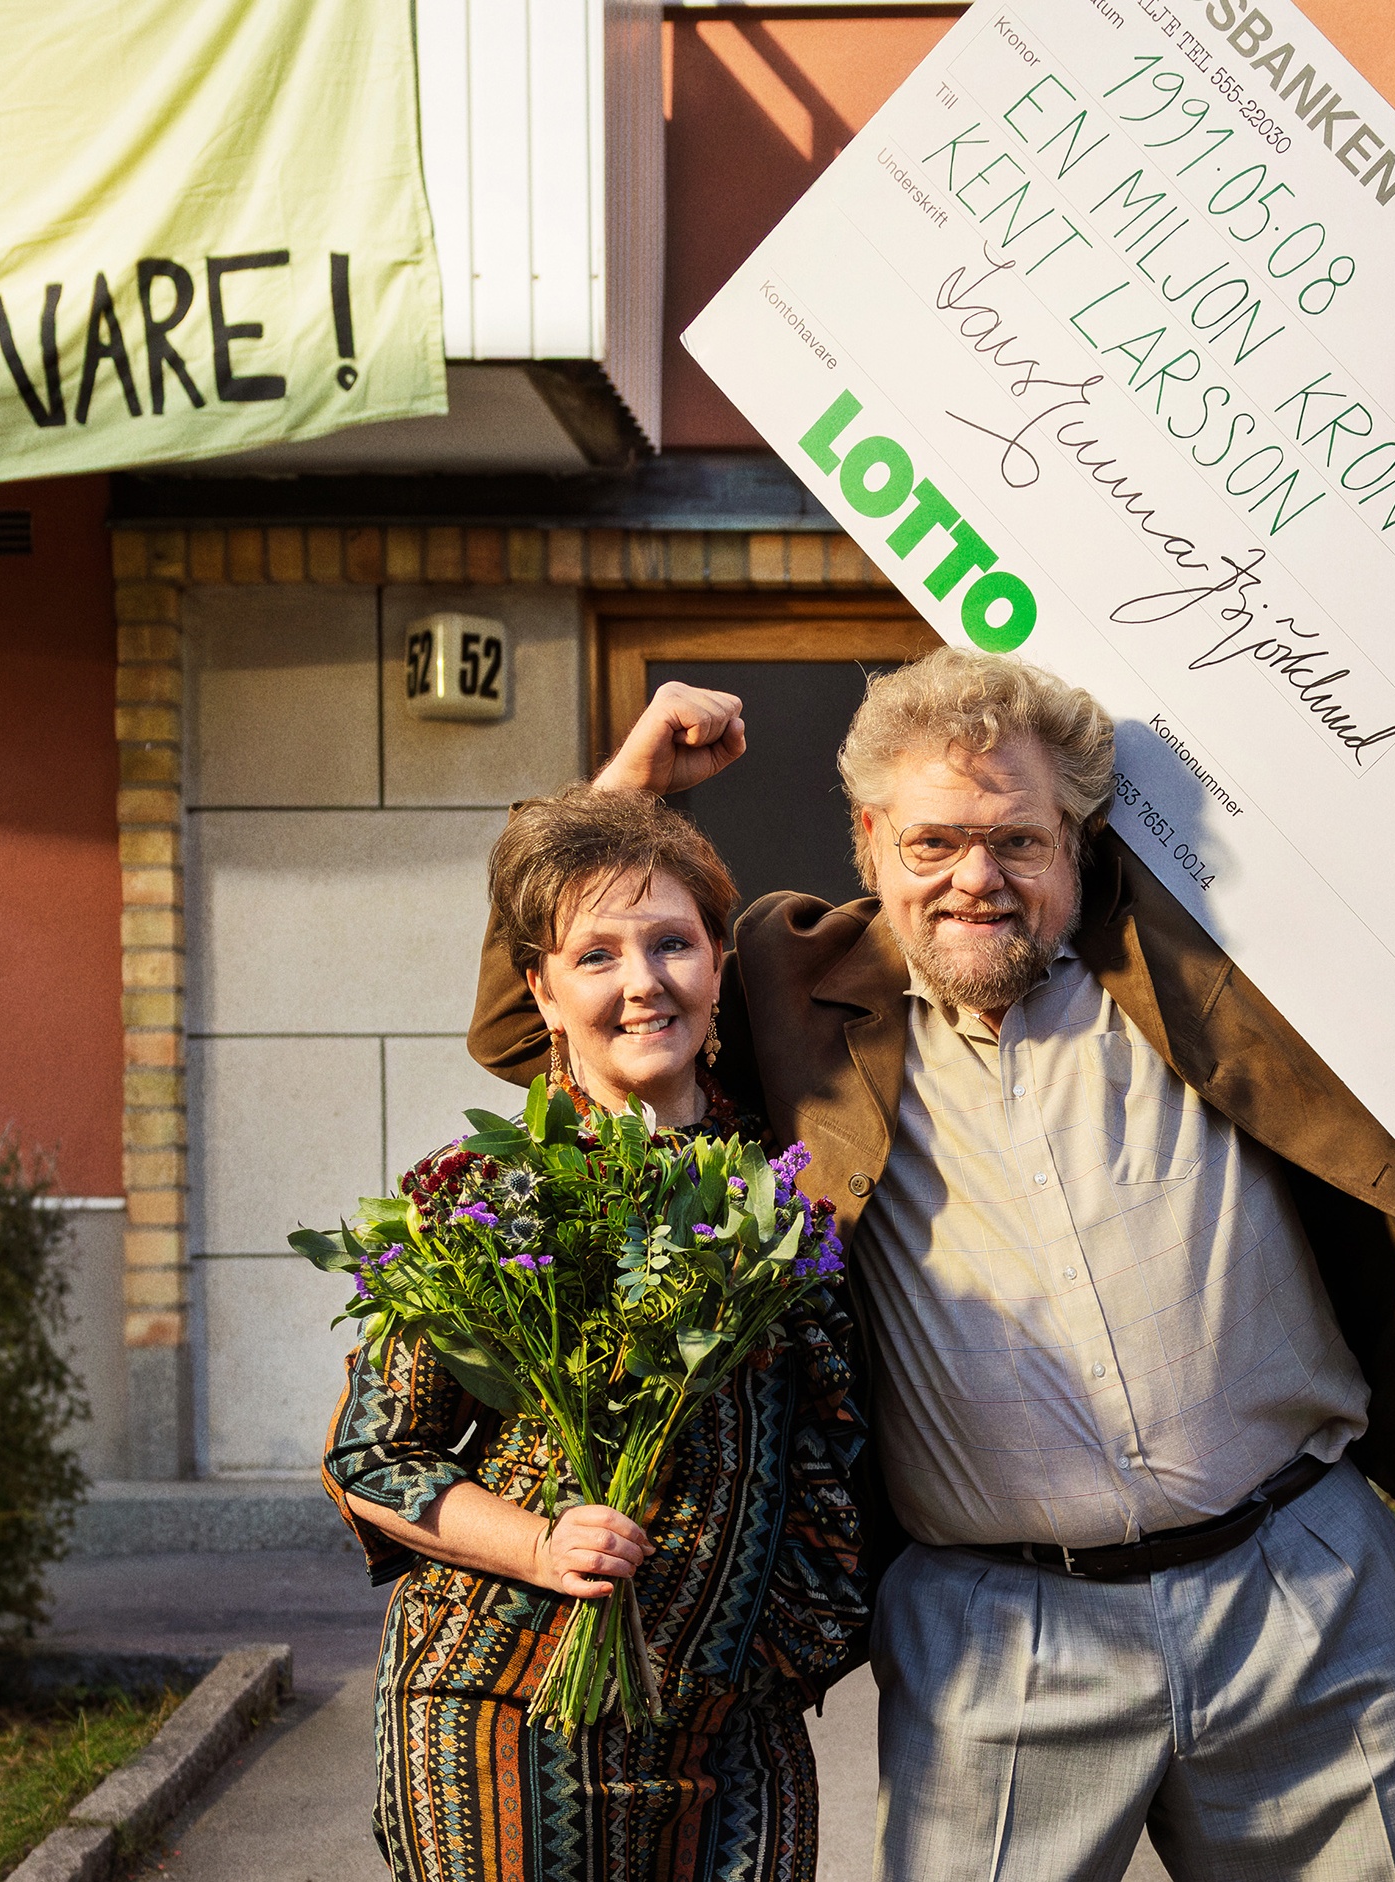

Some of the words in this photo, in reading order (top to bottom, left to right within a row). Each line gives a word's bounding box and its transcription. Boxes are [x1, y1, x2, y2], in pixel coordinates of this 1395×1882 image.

[993, 15, 1041, 67] Kronor
[1090, 0, 1124, 29] tum
[935, 81, 959, 110] Till
[1138, 0, 1182, 37] LJE
[1176, 31, 1213, 73] TEL
[1210, 67, 1293, 155] 555-22030
[877, 147, 949, 229] Underskrift
[1003, 74, 1110, 180] EN
[1090, 169, 1285, 366] MILJON
[759, 280, 838, 370] Kontohavare
[922, 122, 1093, 275] KENT
[1069, 282, 1326, 536] LARSSON
[798, 389, 1037, 654] LOTTO
[407, 630, 432, 698] 52
[459, 633, 502, 700] 52
[1149, 713, 1244, 818] Kontonummer
[1111, 764, 1142, 806] 653
[1137, 800, 1175, 848] 7651
[1173, 843, 1216, 892] 0014
